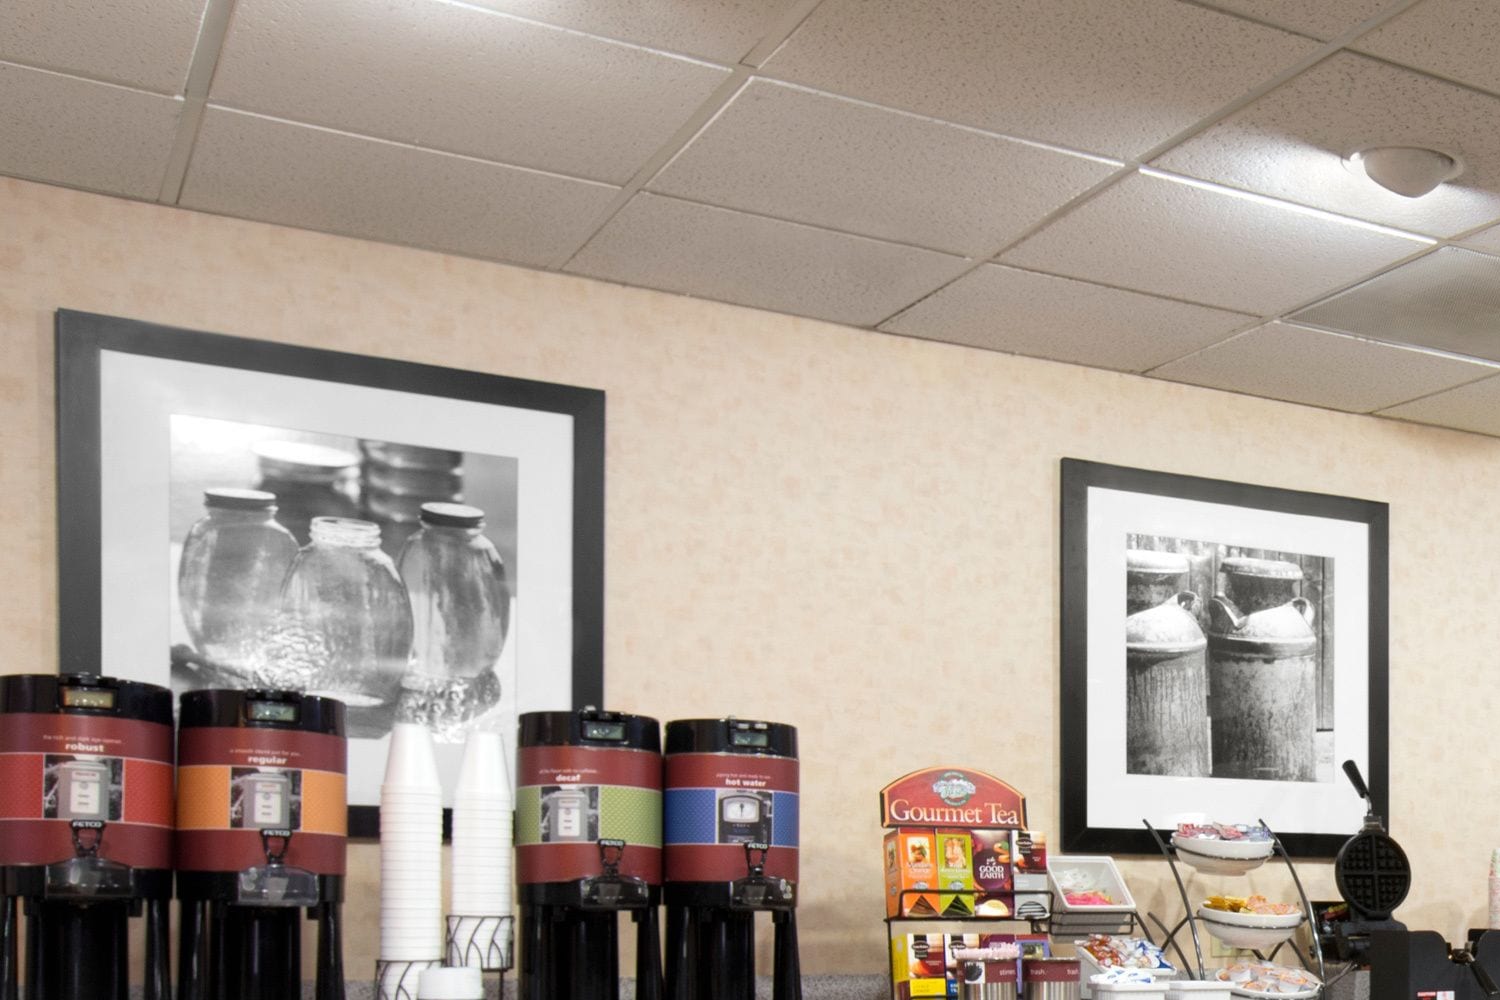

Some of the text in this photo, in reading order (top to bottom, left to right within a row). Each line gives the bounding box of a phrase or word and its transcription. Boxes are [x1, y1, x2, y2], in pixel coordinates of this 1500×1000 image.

[65, 742, 104, 752] robust
[247, 755, 287, 765] regular
[555, 774, 581, 782] decaf
[725, 778, 740, 786] hot
[890, 799, 1019, 825] Gourmet Tea
[72, 820, 102, 828] FETCO
[979, 865, 1004, 873] GOOD
